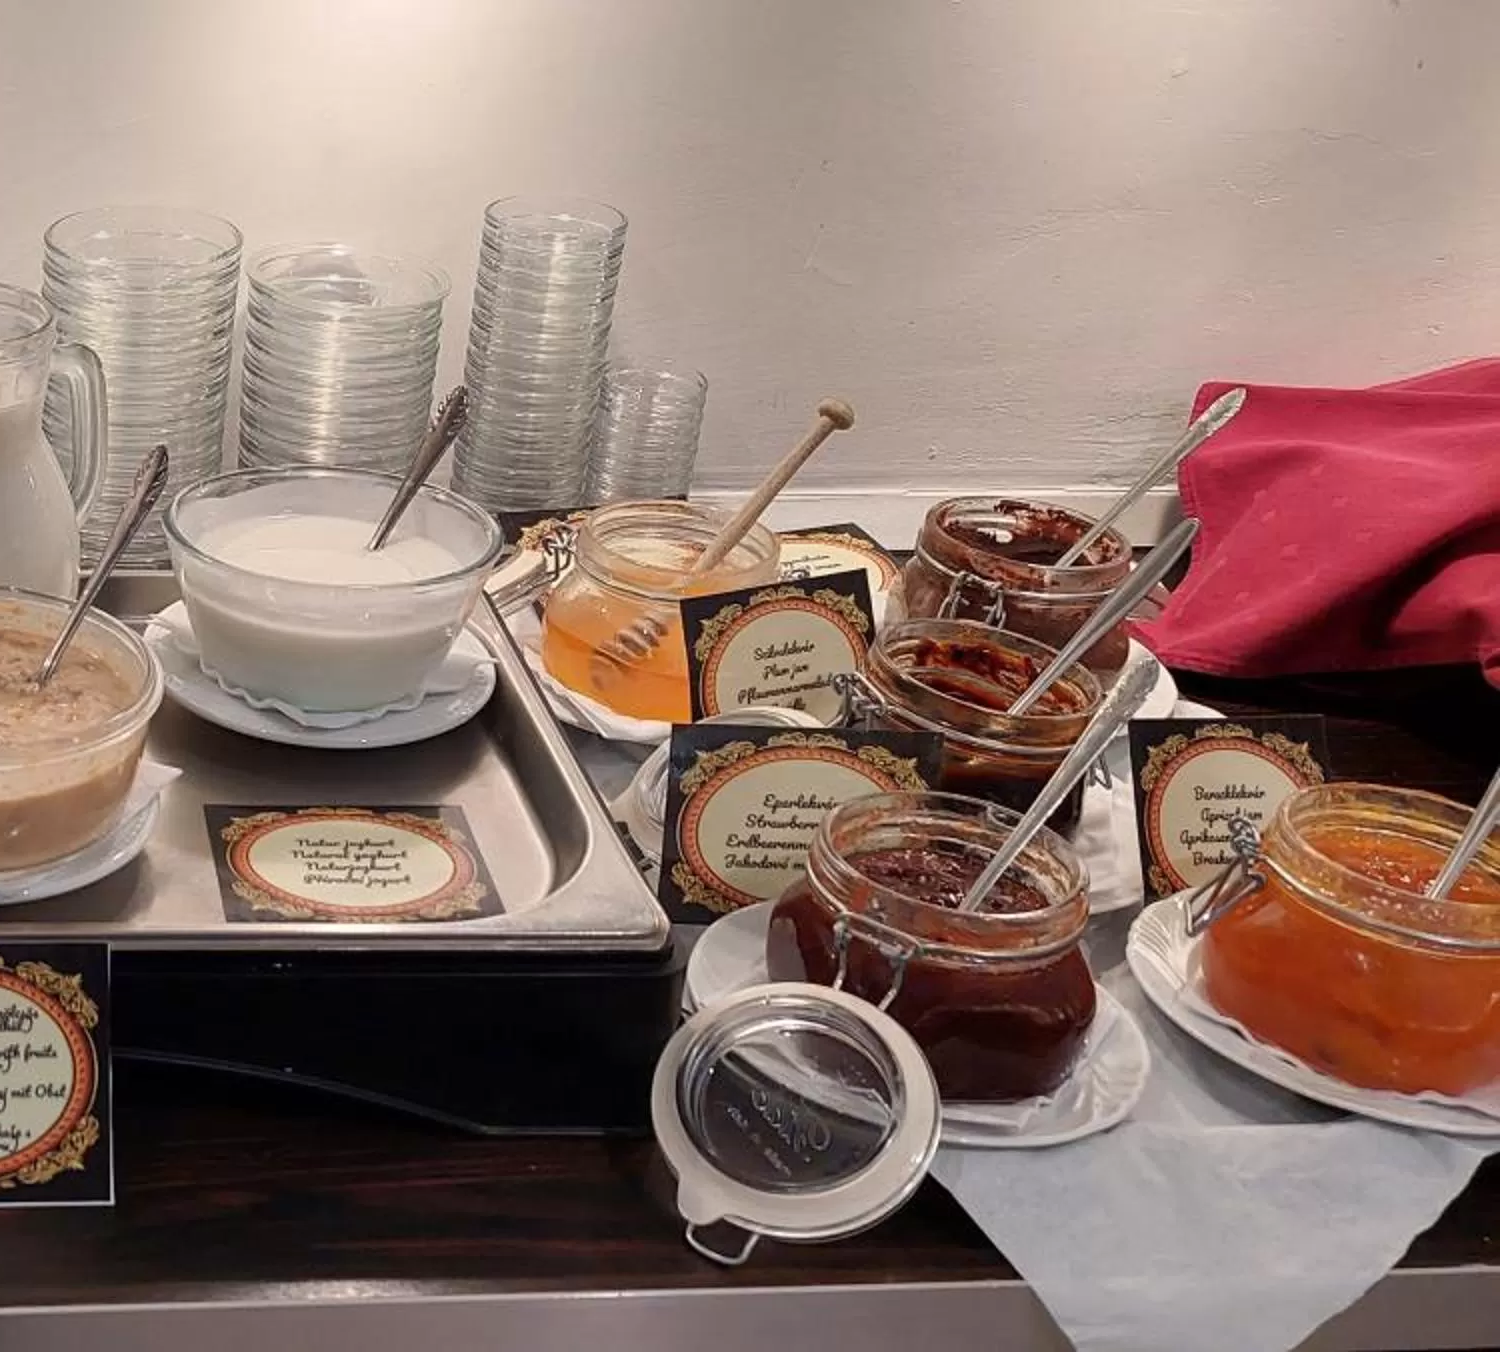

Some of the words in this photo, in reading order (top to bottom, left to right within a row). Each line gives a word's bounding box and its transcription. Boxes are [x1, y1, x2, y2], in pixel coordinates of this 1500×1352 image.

[762, 663, 790, 680] Plum
[737, 672, 833, 704] Pflaumenmarmelad
[745, 814, 820, 829] Strawberr
